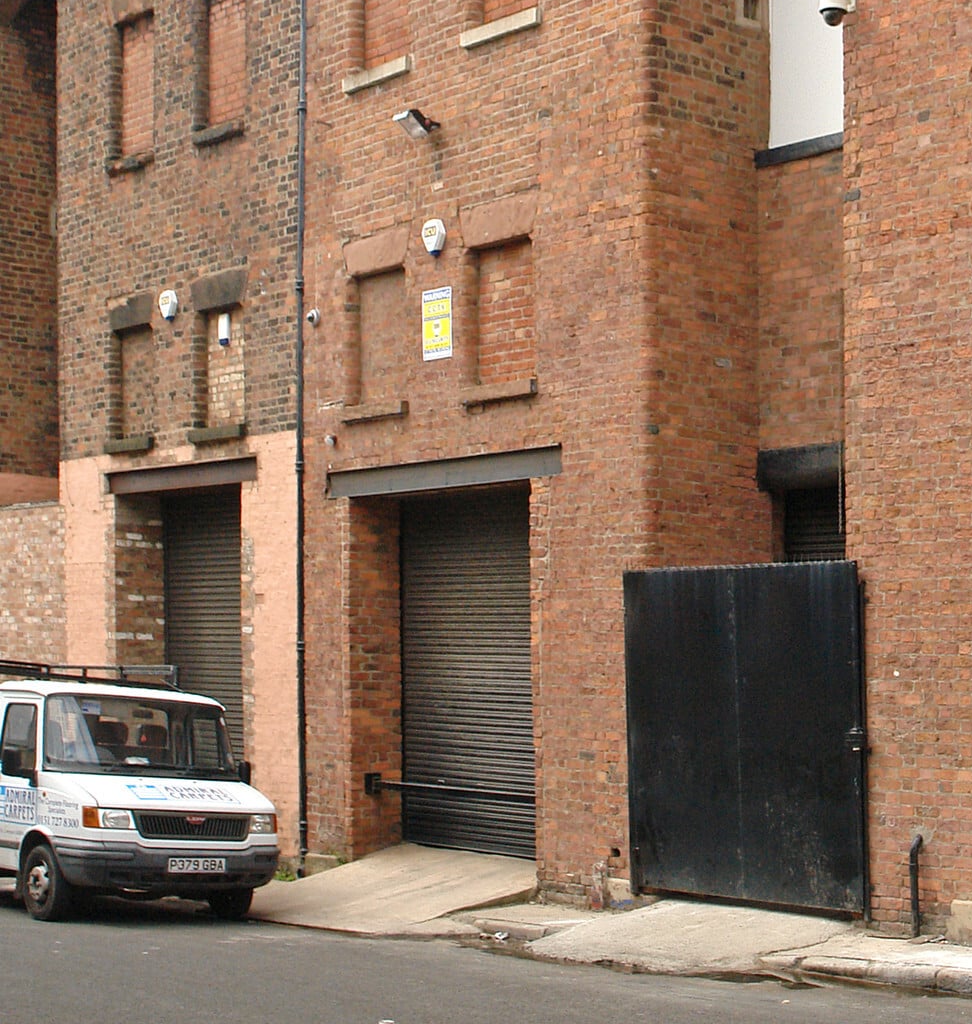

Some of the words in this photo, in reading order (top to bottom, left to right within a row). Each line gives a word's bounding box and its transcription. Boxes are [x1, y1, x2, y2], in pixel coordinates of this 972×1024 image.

[425, 227, 436, 237] ICU
[424, 289, 450, 303] WARNING
[164, 785, 228, 796] ADMIRAL
[5, 789, 36, 806] ADMIRAL
[169, 792, 233, 802] CARPETS
[4, 804, 35, 821] CARPETS
[51, 816, 62, 826] 727
[63, 817, 79, 828] 8300
[170, 860, 200, 870] P379
[203, 860, 224, 870] GBA
